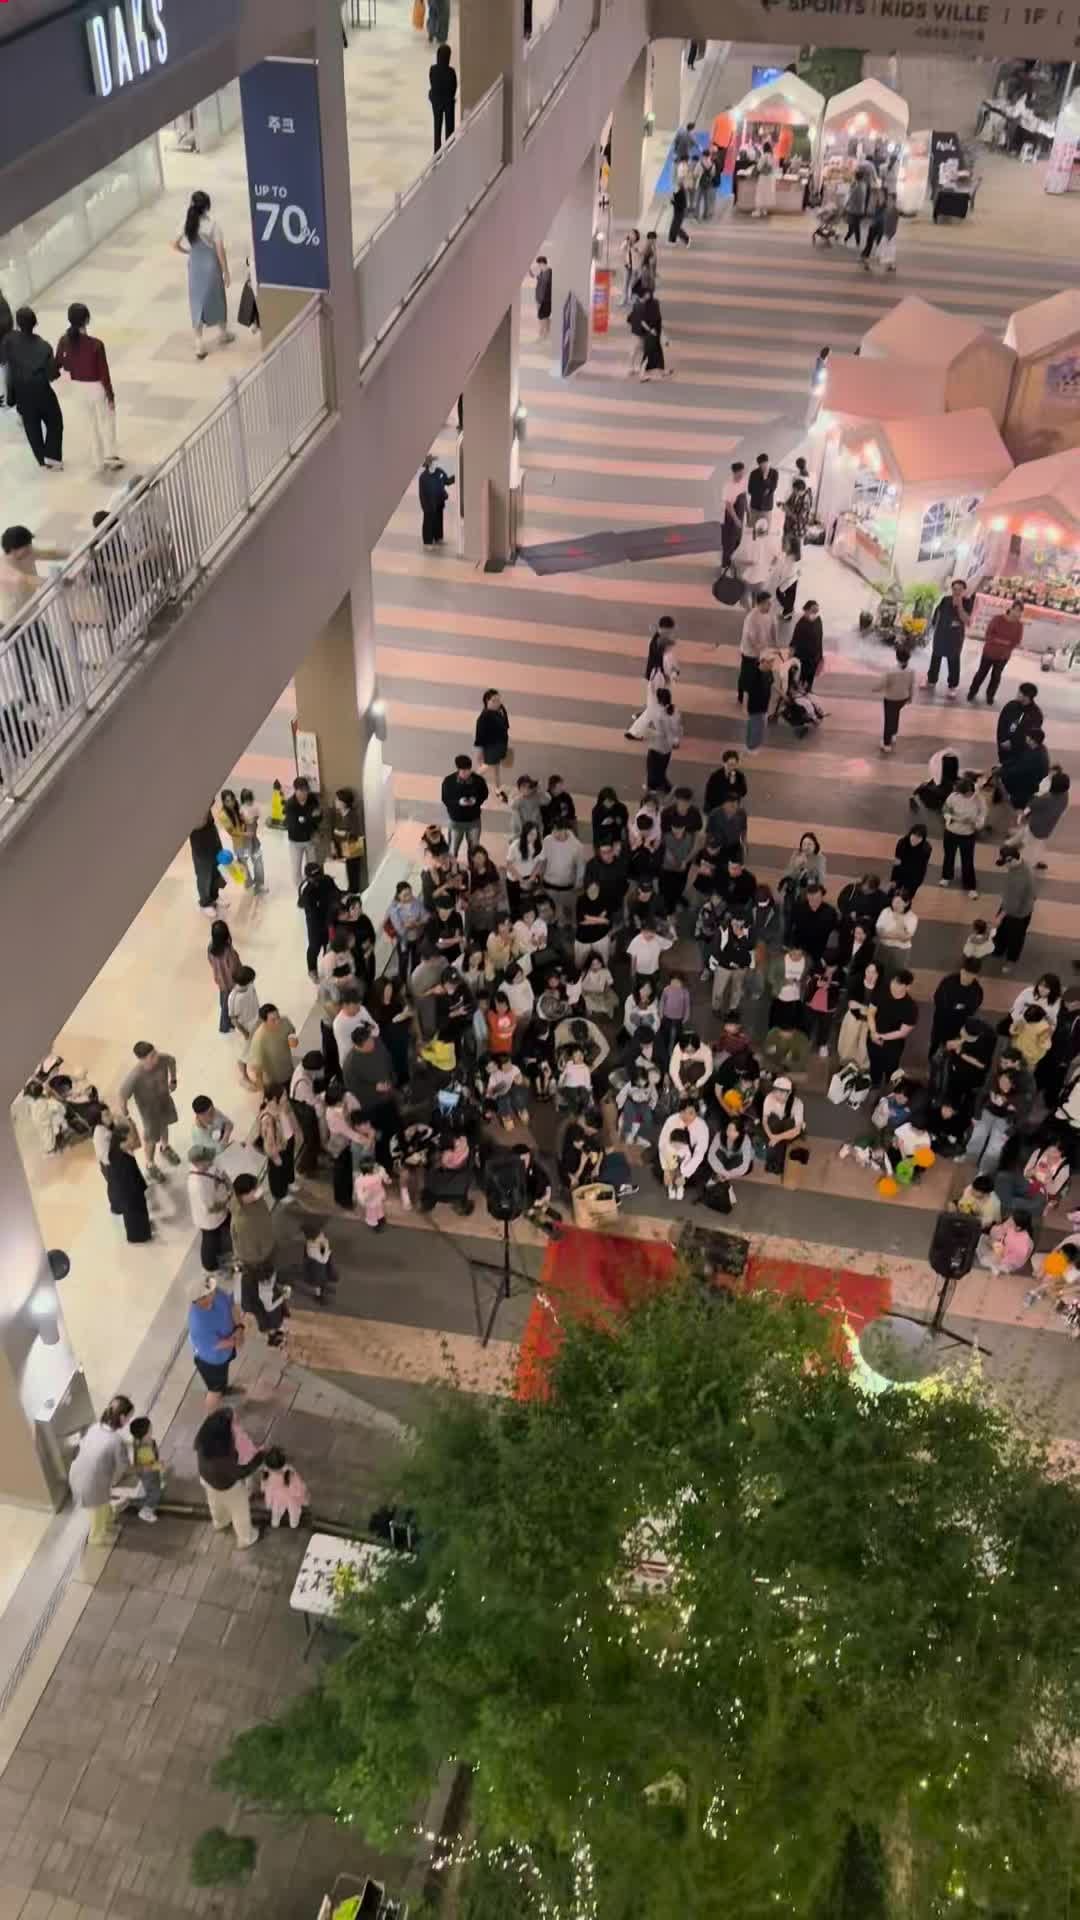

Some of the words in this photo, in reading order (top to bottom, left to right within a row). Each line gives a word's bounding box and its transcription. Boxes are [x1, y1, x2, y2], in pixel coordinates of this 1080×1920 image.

[789, 0, 866, 15] SPORTS
[880, 1, 927, 19] KIDS
[933, 3, 990, 22] VILLE
[1024, 8, 1048, 24] 1F
[87, 0, 168, 96] DAKS
[254, 184, 270, 197] UP
[271, 186, 288, 198] TO
[255, 202, 320, 246] 70%
